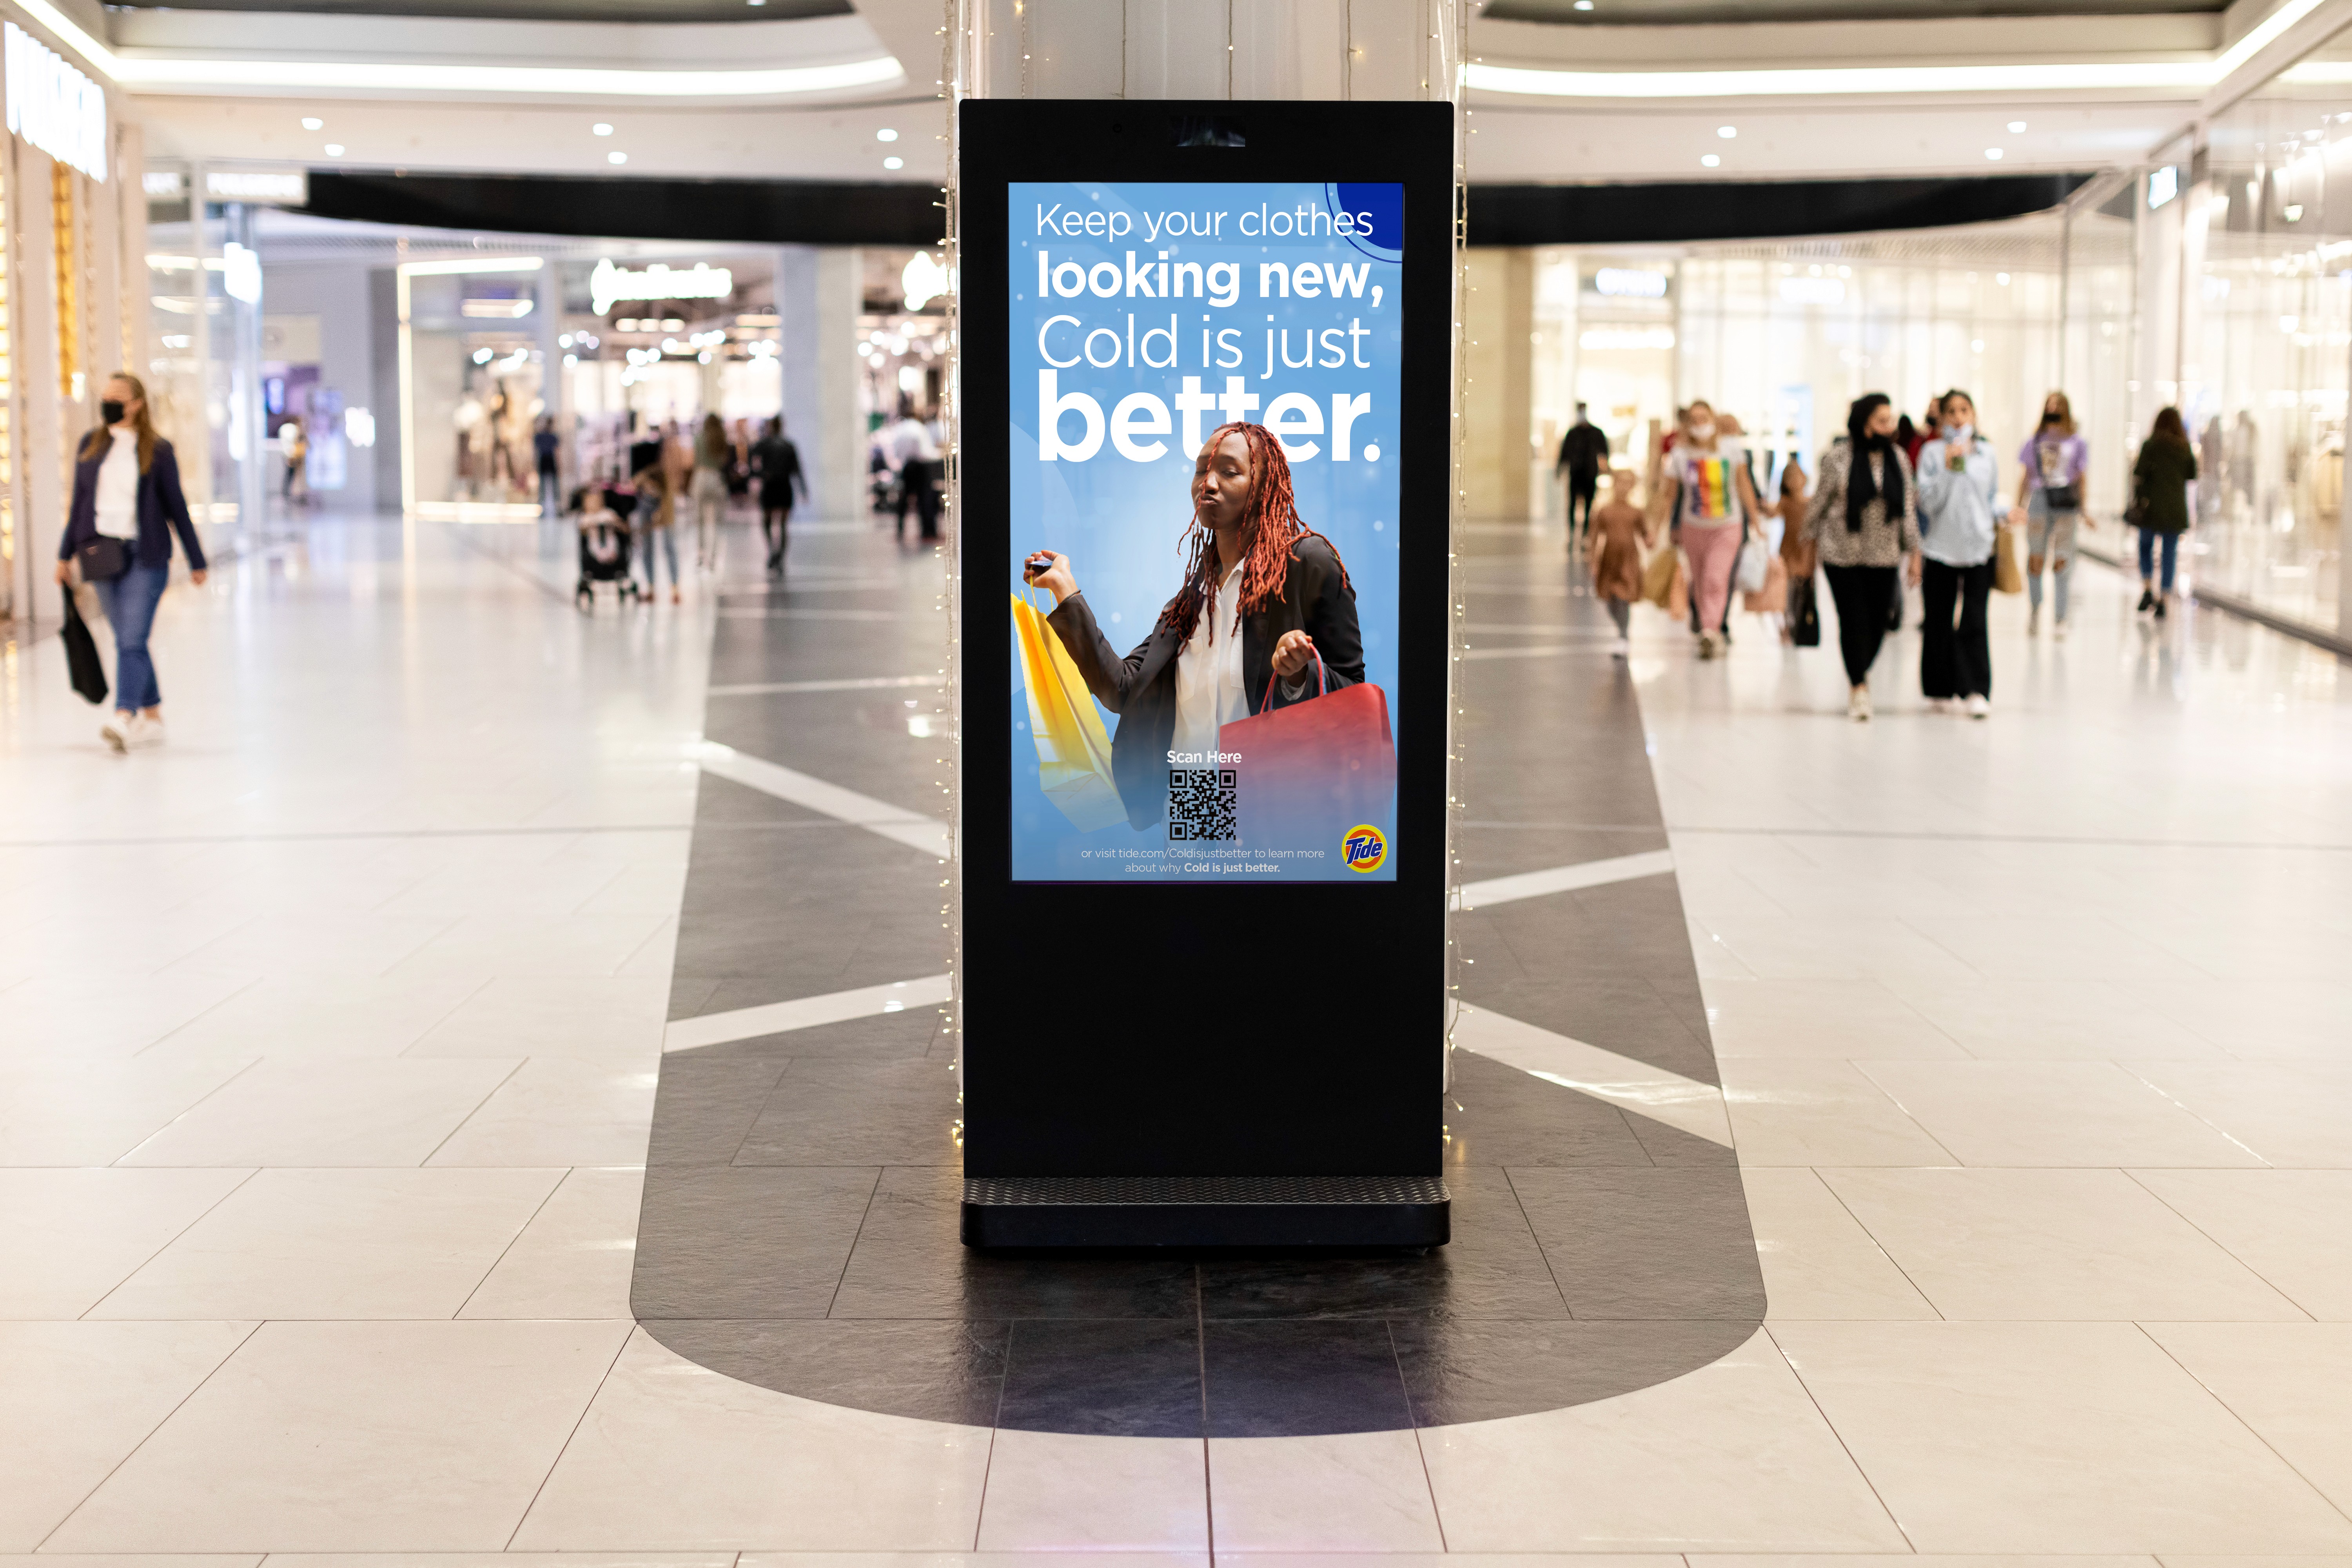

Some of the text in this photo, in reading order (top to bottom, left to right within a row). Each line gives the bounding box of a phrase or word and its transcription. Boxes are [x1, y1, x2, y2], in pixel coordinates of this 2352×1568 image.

[1037, 203, 1373, 242] Keep your clothes
[1039, 250, 1383, 307] looking new,
[1038, 313, 1370, 379] Cold is just
[1039, 369, 1381, 463] better.
[1167, 750, 1242, 763] Scan Here
[1095, 848, 1116, 858] visit
[1119, 847, 1252, 860] tide.com/Coldisjustbetter
[1255, 849, 1265, 858] to
[1269, 848, 1294, 858] learn
[1345, 836, 1383, 865] Tide
[1125, 863, 1280, 874] about why Cold is just better.
